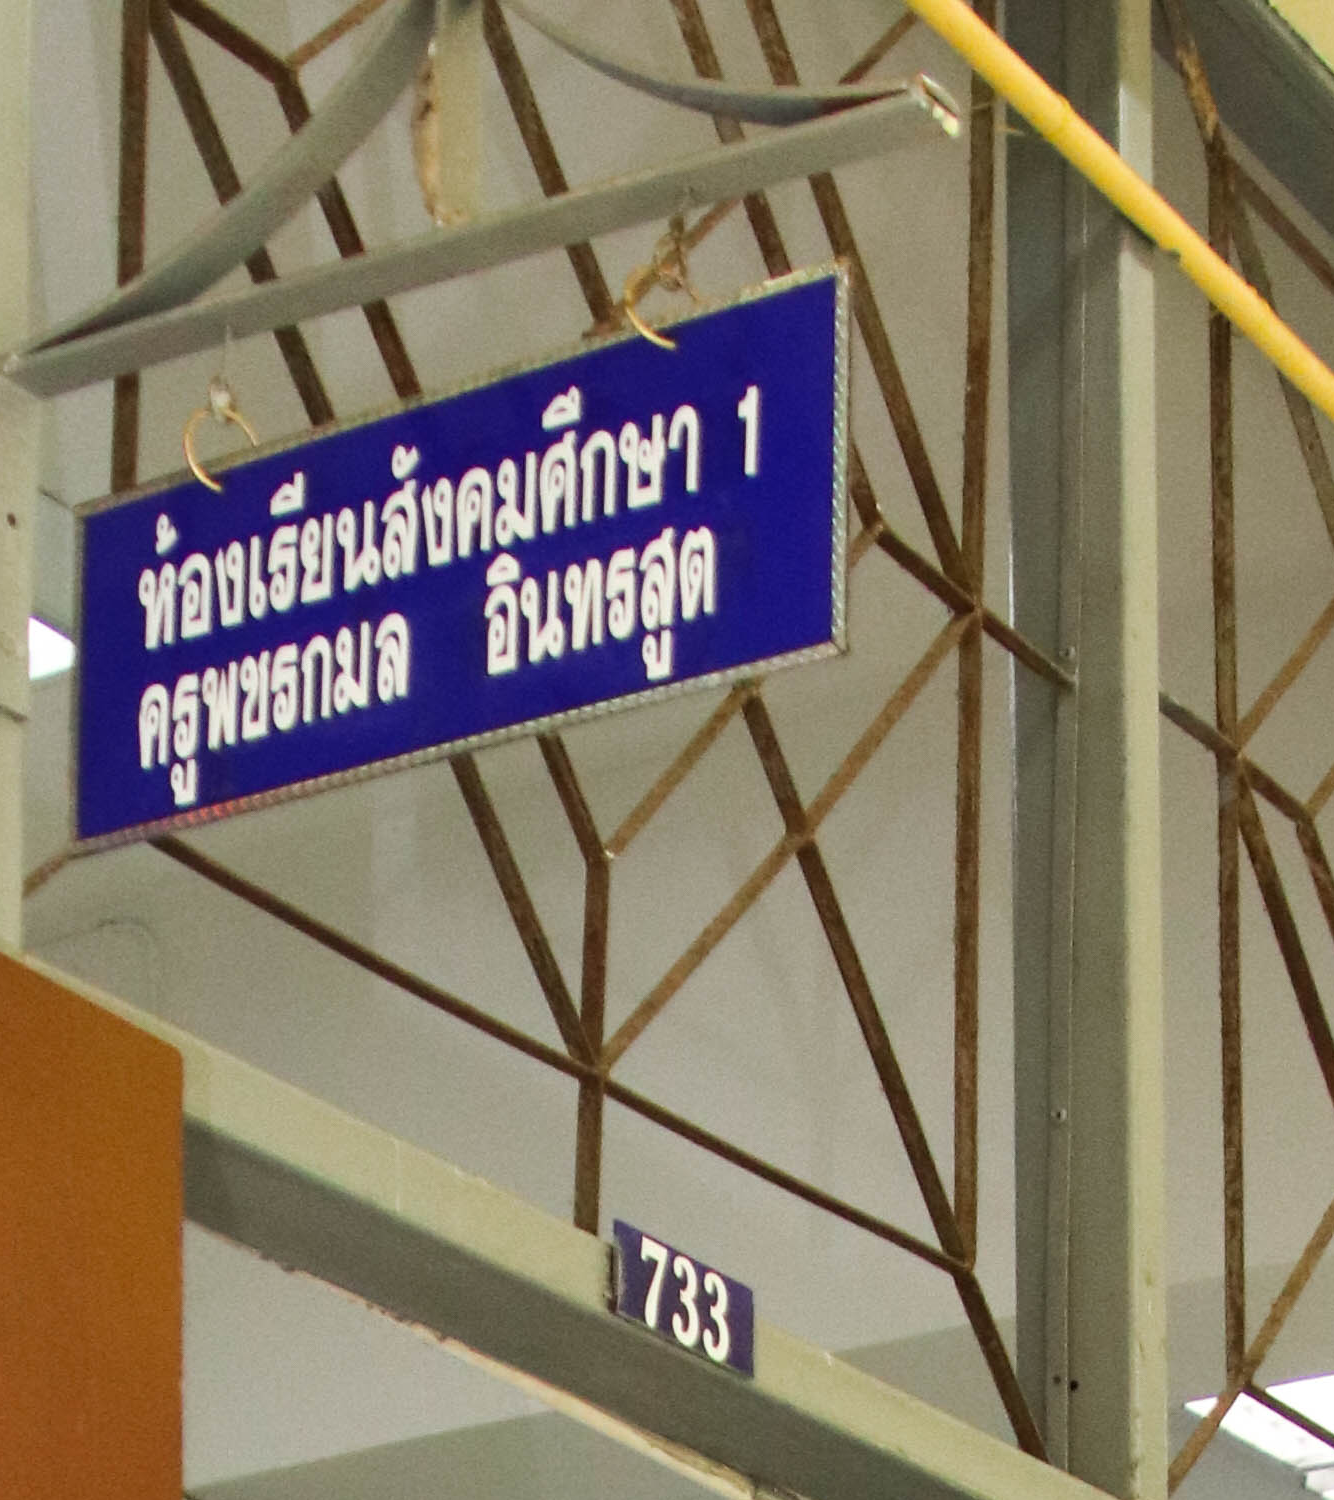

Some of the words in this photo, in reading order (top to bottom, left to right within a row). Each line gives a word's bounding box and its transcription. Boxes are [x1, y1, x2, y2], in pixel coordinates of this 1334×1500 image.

[138, 385, 701, 650] ห้องเรียนสังคมศึกษา
[737, 385, 760, 476] 1
[484, 525, 716, 681] อินทรสูต
[640, 1236, 730, 1362] 733
